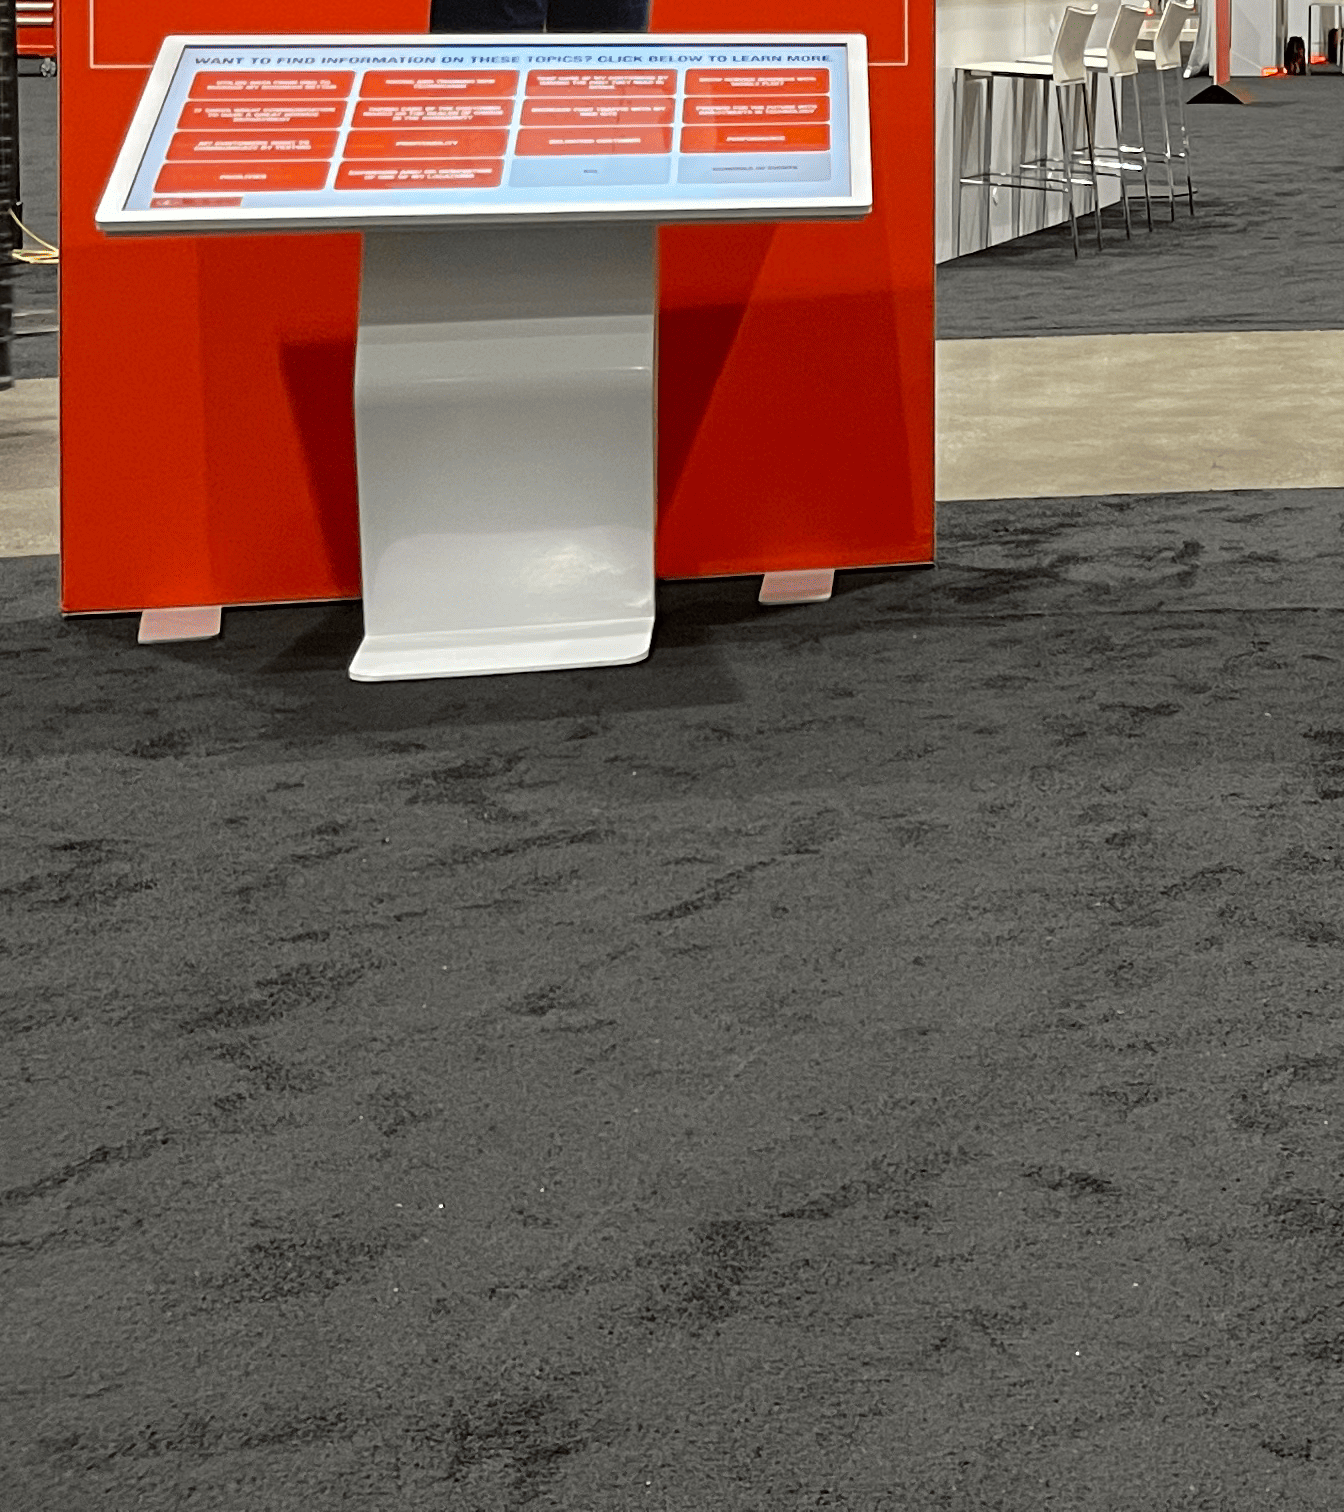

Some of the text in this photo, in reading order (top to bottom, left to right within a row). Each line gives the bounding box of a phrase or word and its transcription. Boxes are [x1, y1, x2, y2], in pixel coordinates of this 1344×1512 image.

[195, 56, 245, 65] WANT
[251, 56, 271, 64] TO
[276, 56, 316, 64] FIND
[321, 56, 436, 64] INFORMATION
[597, 55, 643, 63] CLICK
[648, 55, 703, 63] BELOW
[709, 54, 727, 62] TO
[732, 54, 782, 63] LEARN
